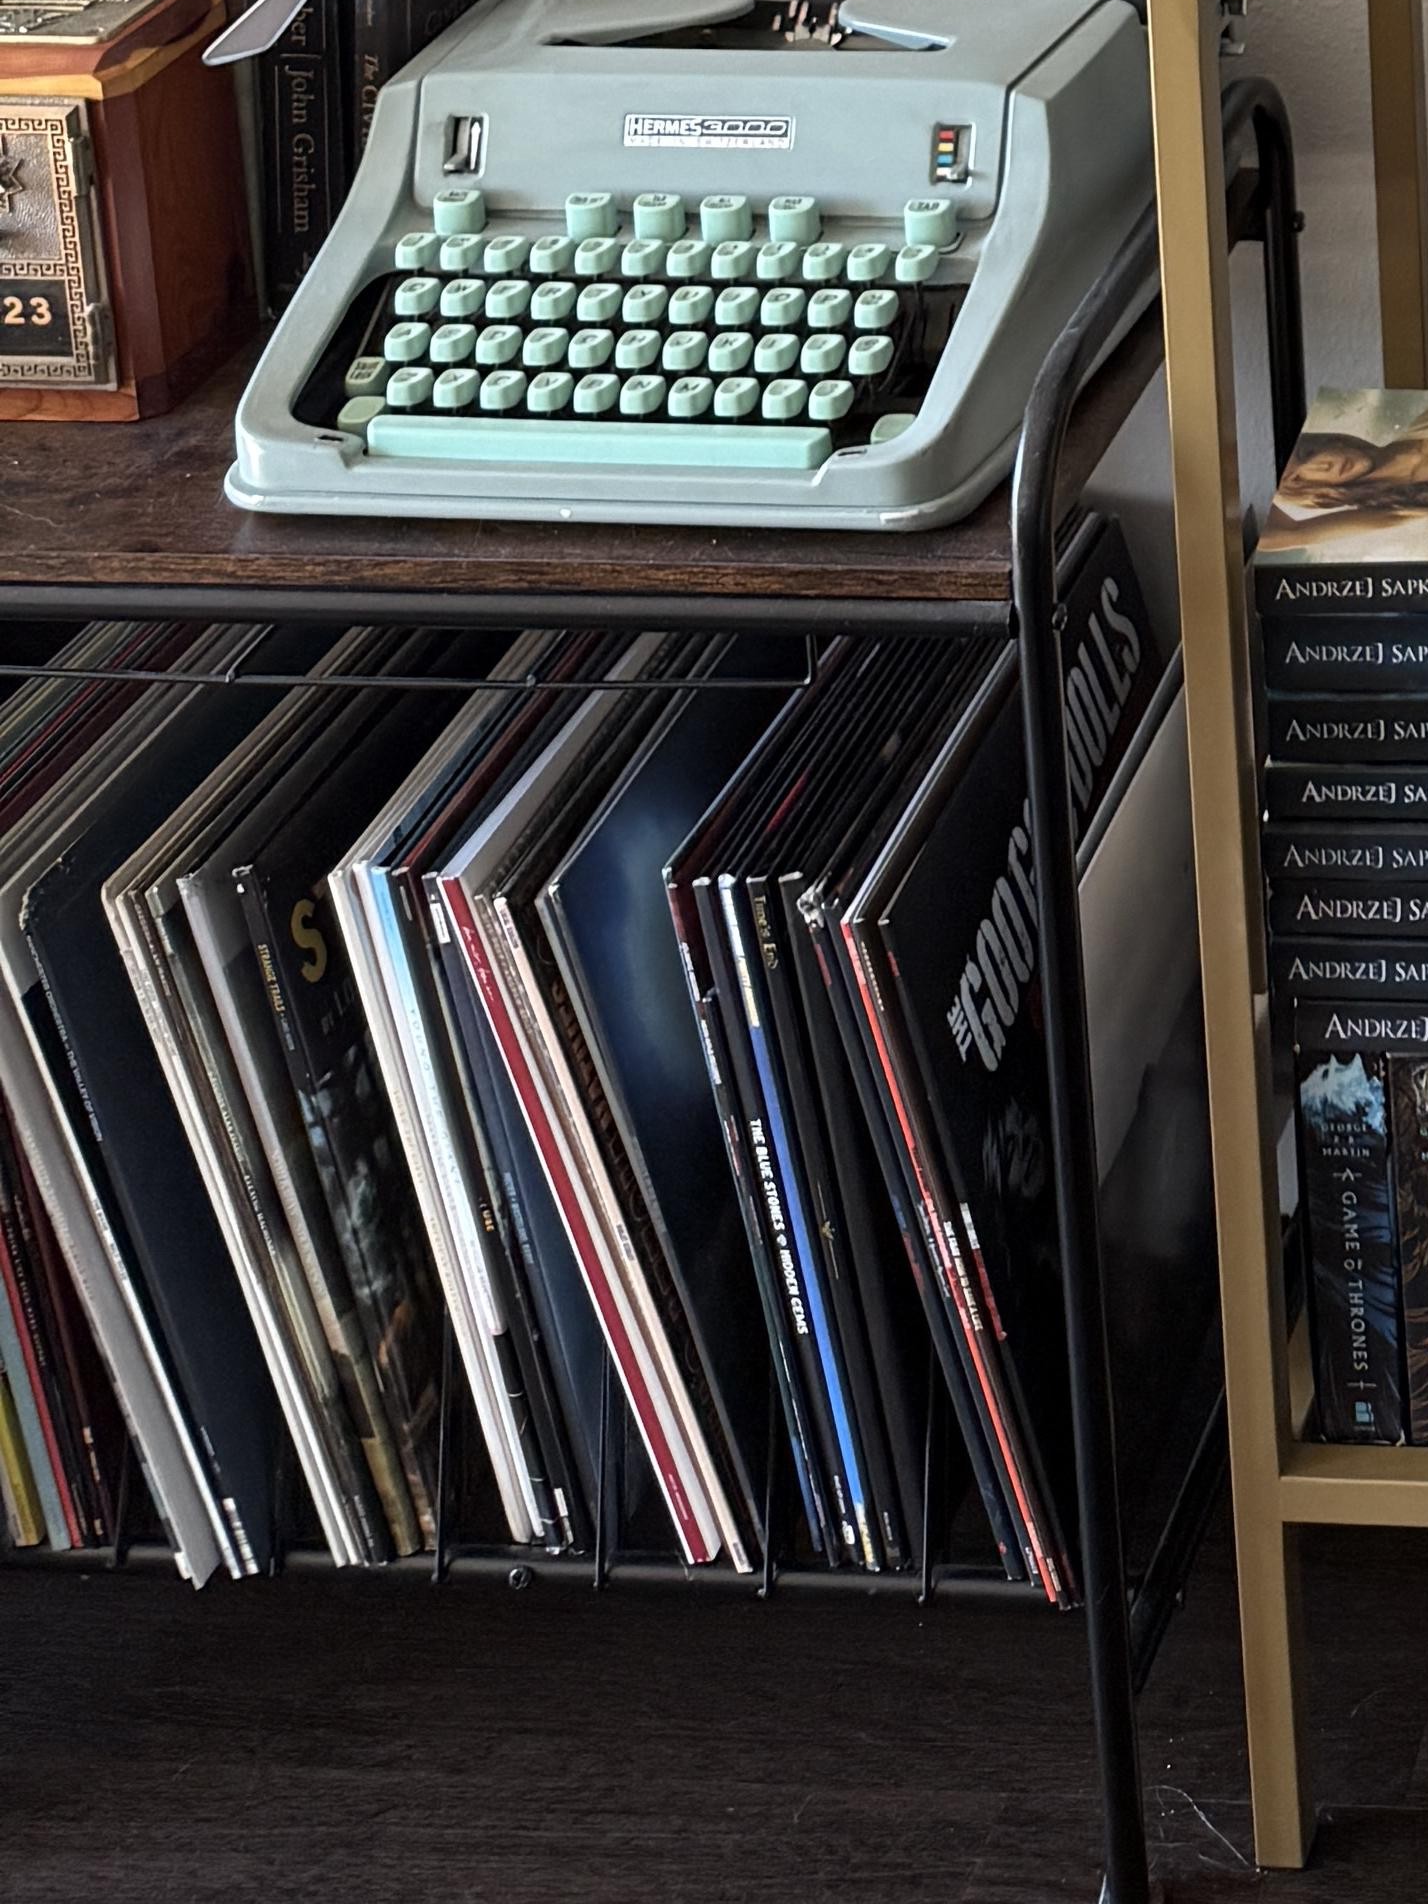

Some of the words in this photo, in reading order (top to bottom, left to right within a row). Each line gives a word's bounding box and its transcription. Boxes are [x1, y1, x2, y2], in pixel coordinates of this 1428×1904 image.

[286, 65, 314, 123] John
[630, 119, 701, 135] HERMES
[701, 121, 787, 135] 3000
[292, 133, 316, 233] Grisham
